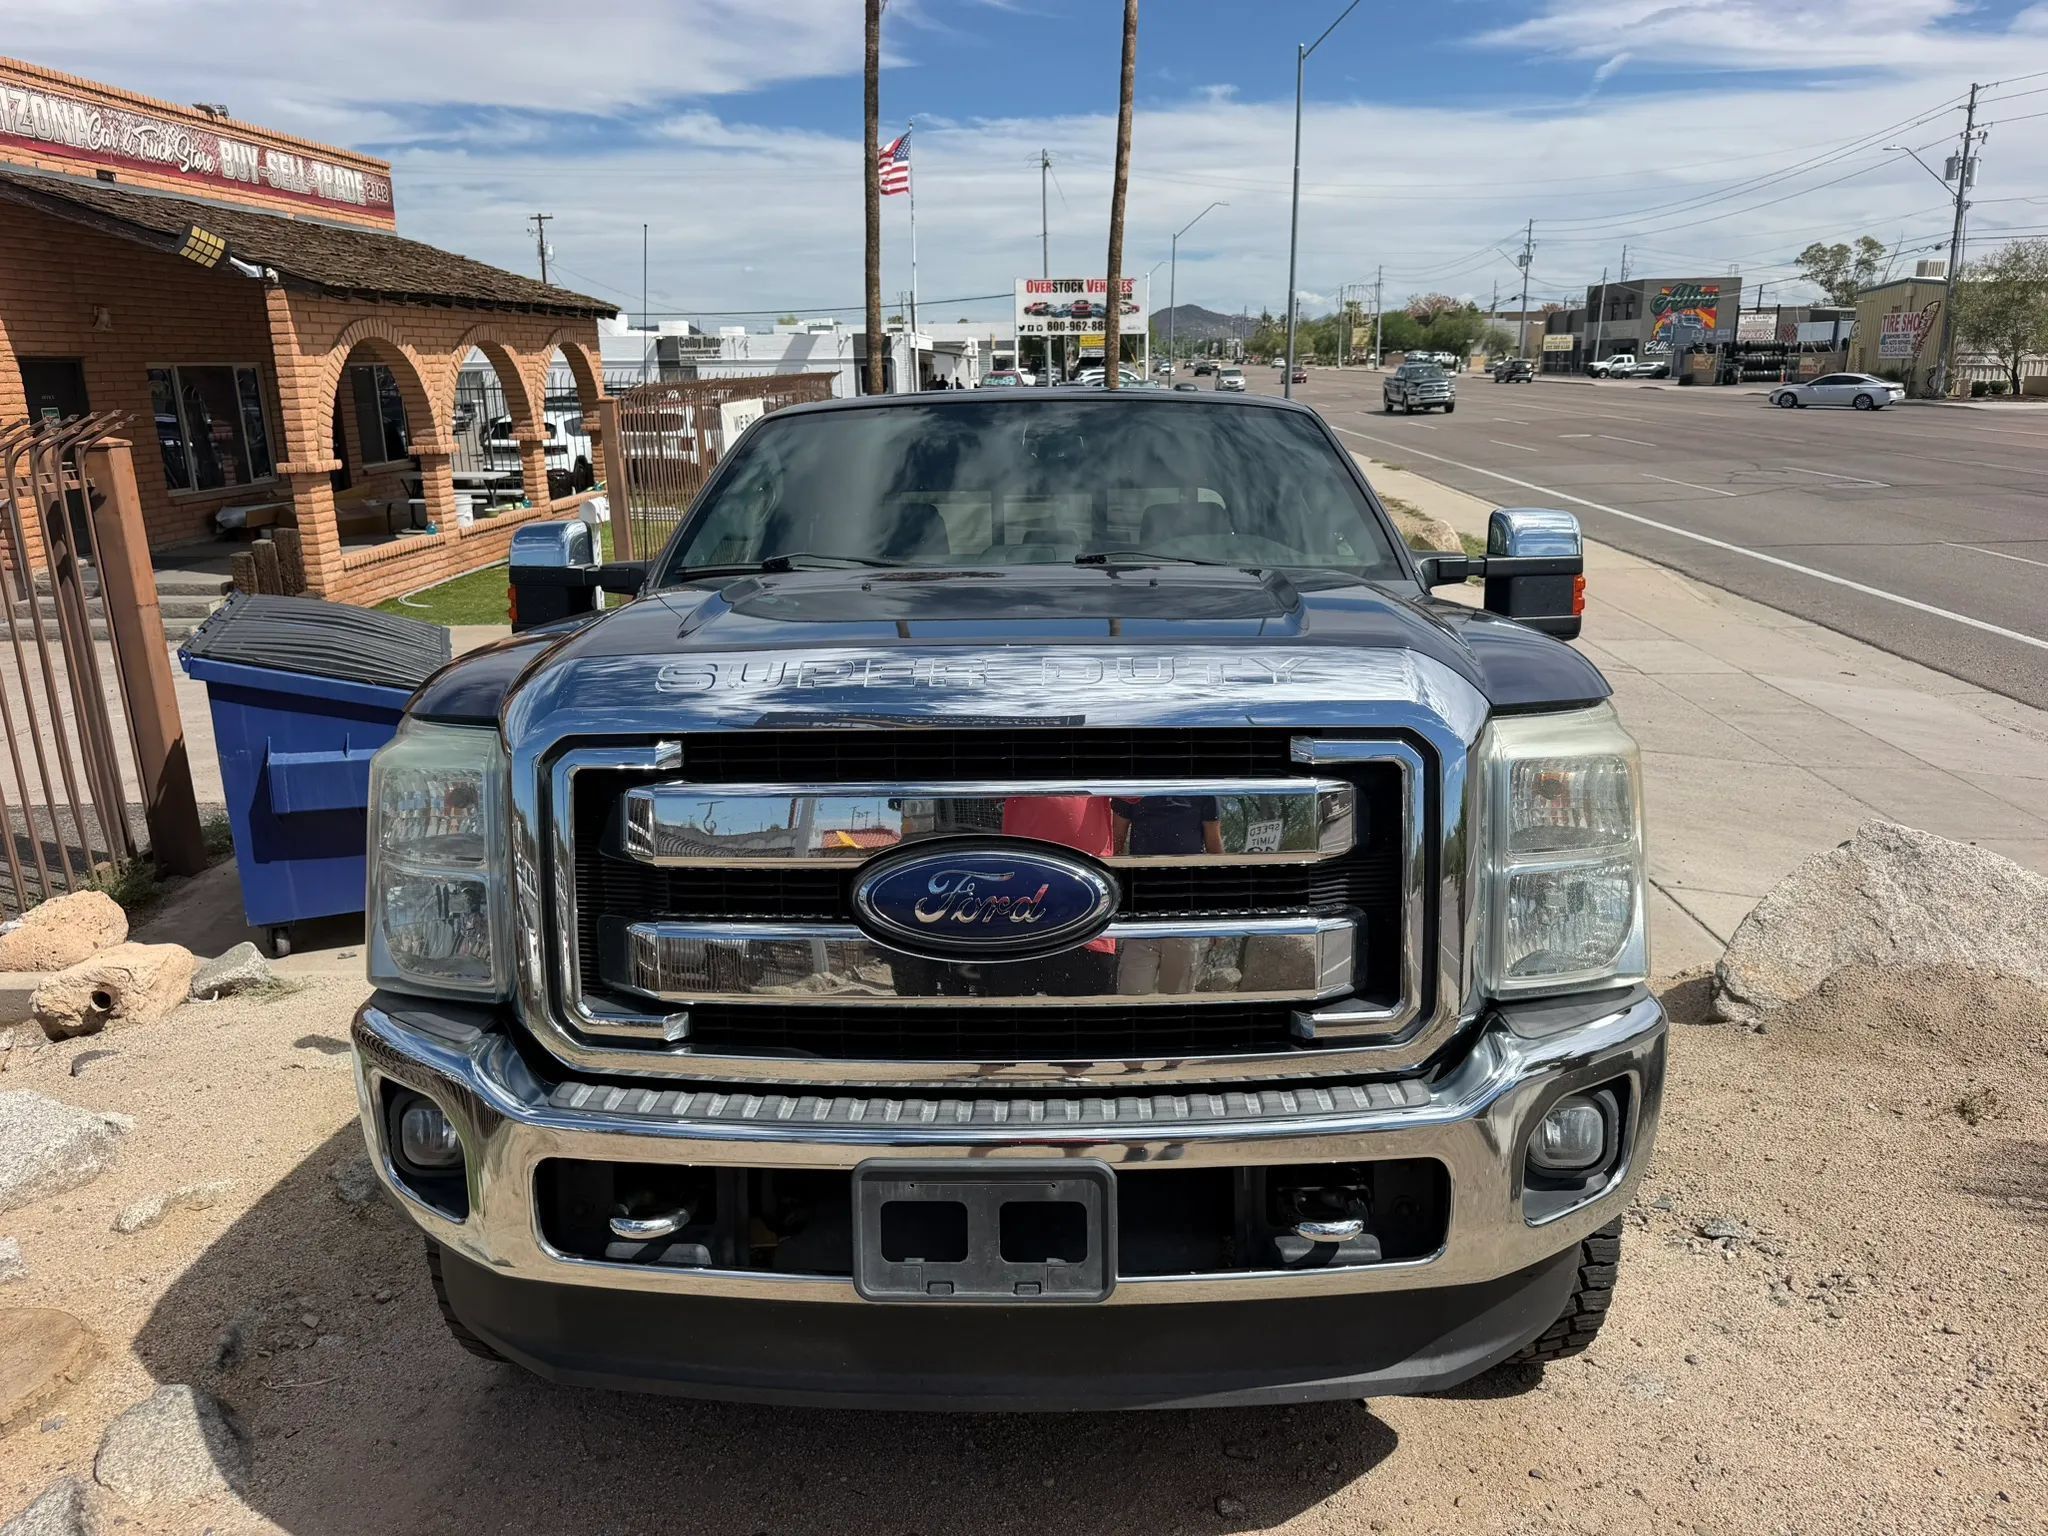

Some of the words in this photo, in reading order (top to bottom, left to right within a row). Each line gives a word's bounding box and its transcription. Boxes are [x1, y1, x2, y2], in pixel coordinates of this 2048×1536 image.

[0, 86, 92, 150] IZONA
[87, 110, 119, 151] Car
[132, 125, 176, 162] Truck
[174, 133, 216, 173] Store
[366, 181, 389, 204] 2148
[1026, 279, 1084, 294] OVERSTOCK
[1086, 279, 1133, 293] VEHES
[1047, 320, 1107, 333] 800-962-88
[1882, 314, 1901, 333] TIRE
[1901, 312, 1922, 332] SHO
[703, 336, 721, 348] Auto
[655, 658, 991, 694] SUPER
[1041, 656, 1312, 686] DUTY
[914, 869, 1049, 924] Ford
